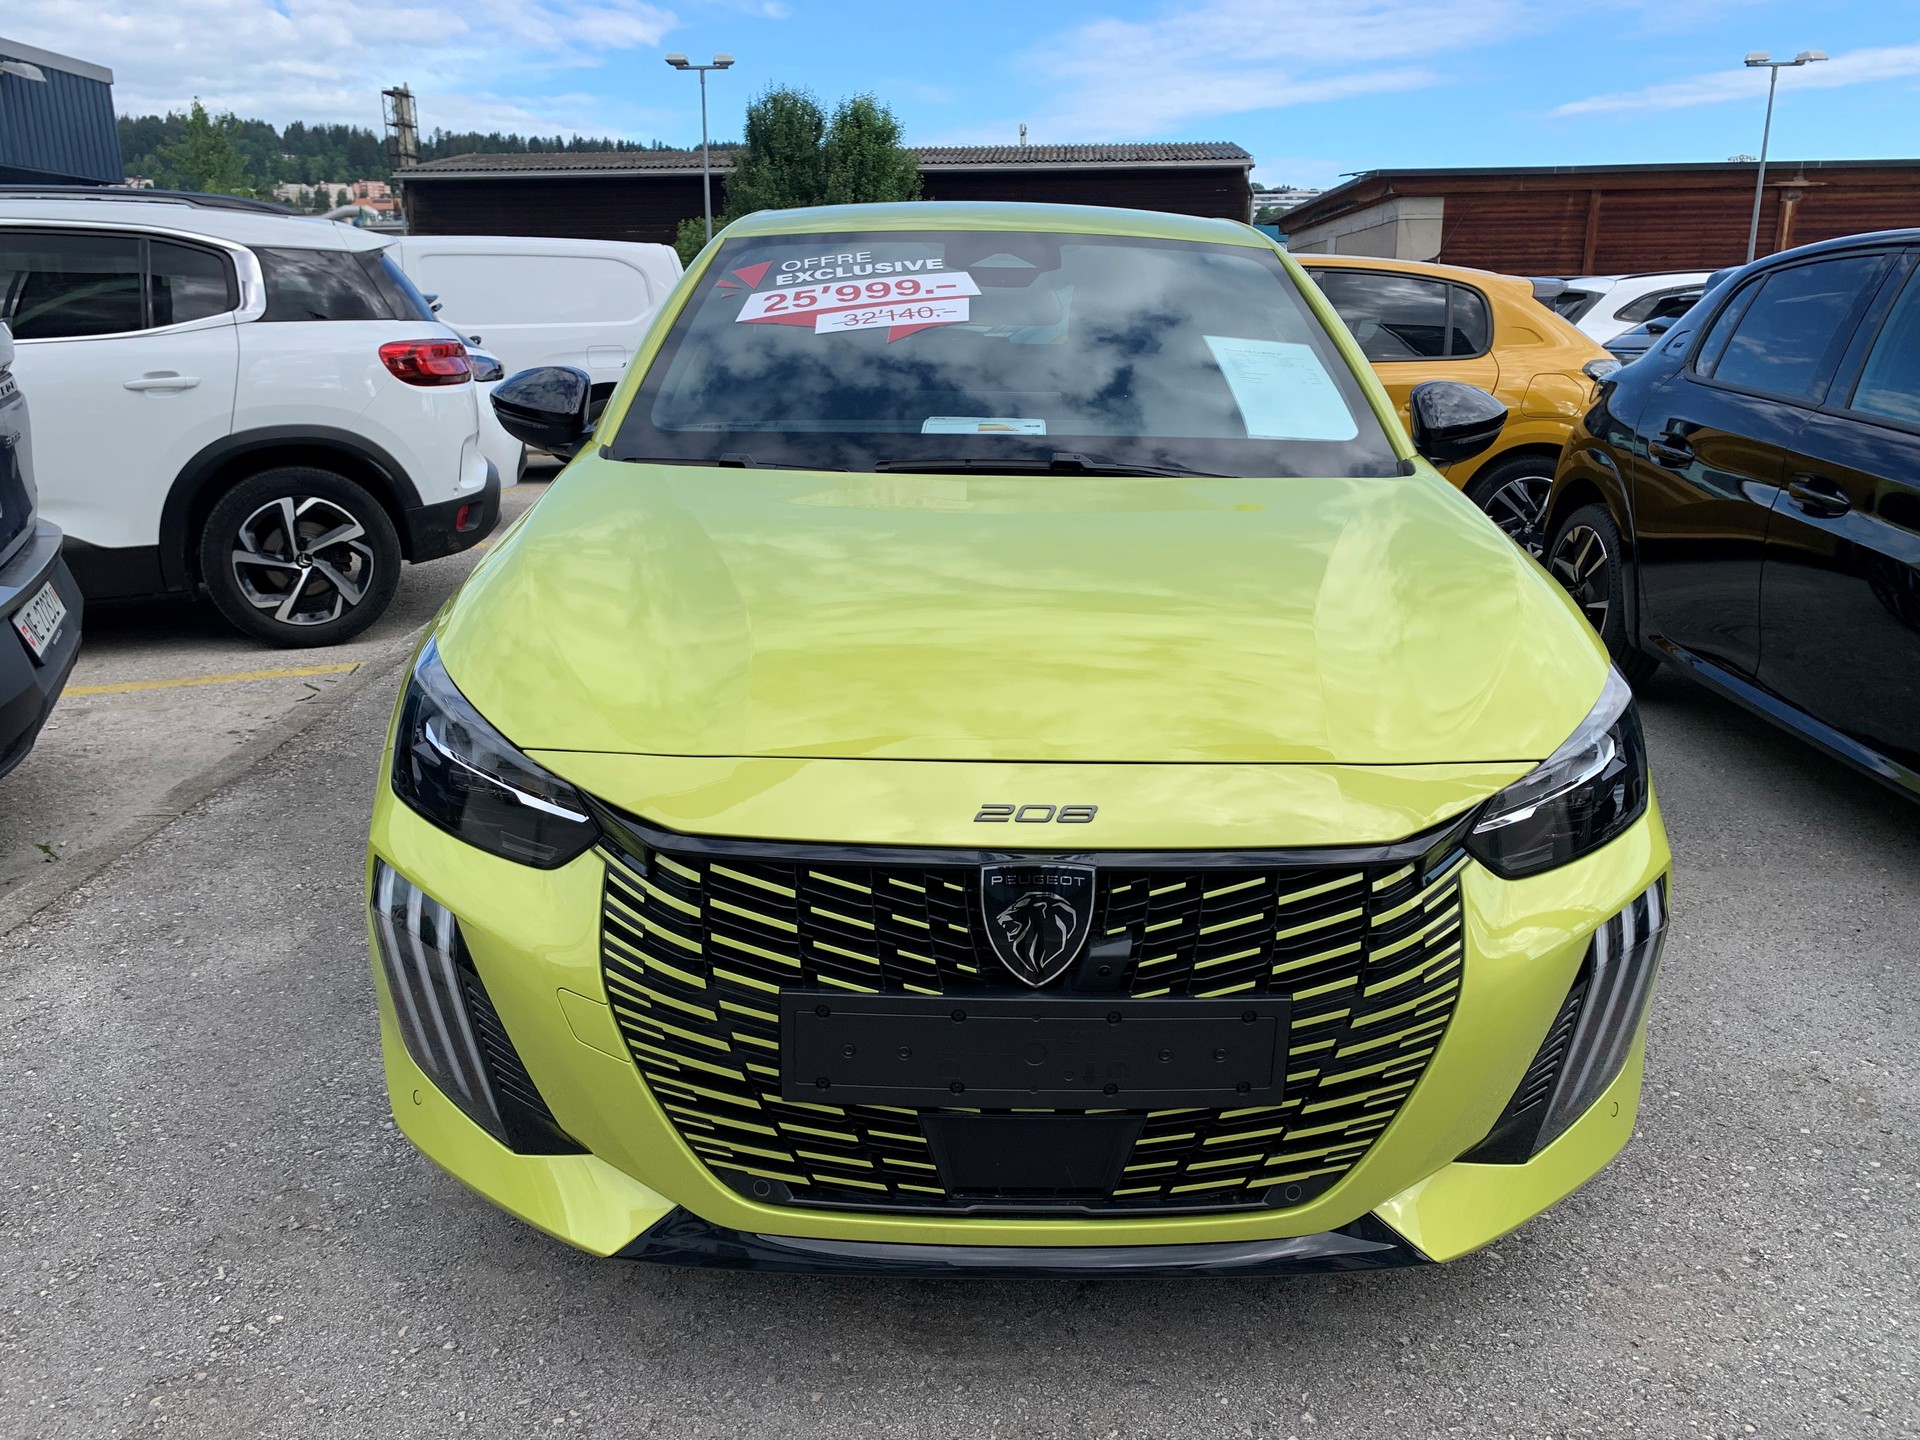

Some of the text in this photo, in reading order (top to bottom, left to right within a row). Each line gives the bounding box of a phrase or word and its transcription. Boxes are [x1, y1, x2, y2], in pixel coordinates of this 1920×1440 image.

[775, 258, 944, 286] EXCLUSIVE
[781, 251, 872, 272] OFFRE
[973, 803, 1099, 824] 208
[991, 875, 1086, 886] PEUGEOT
